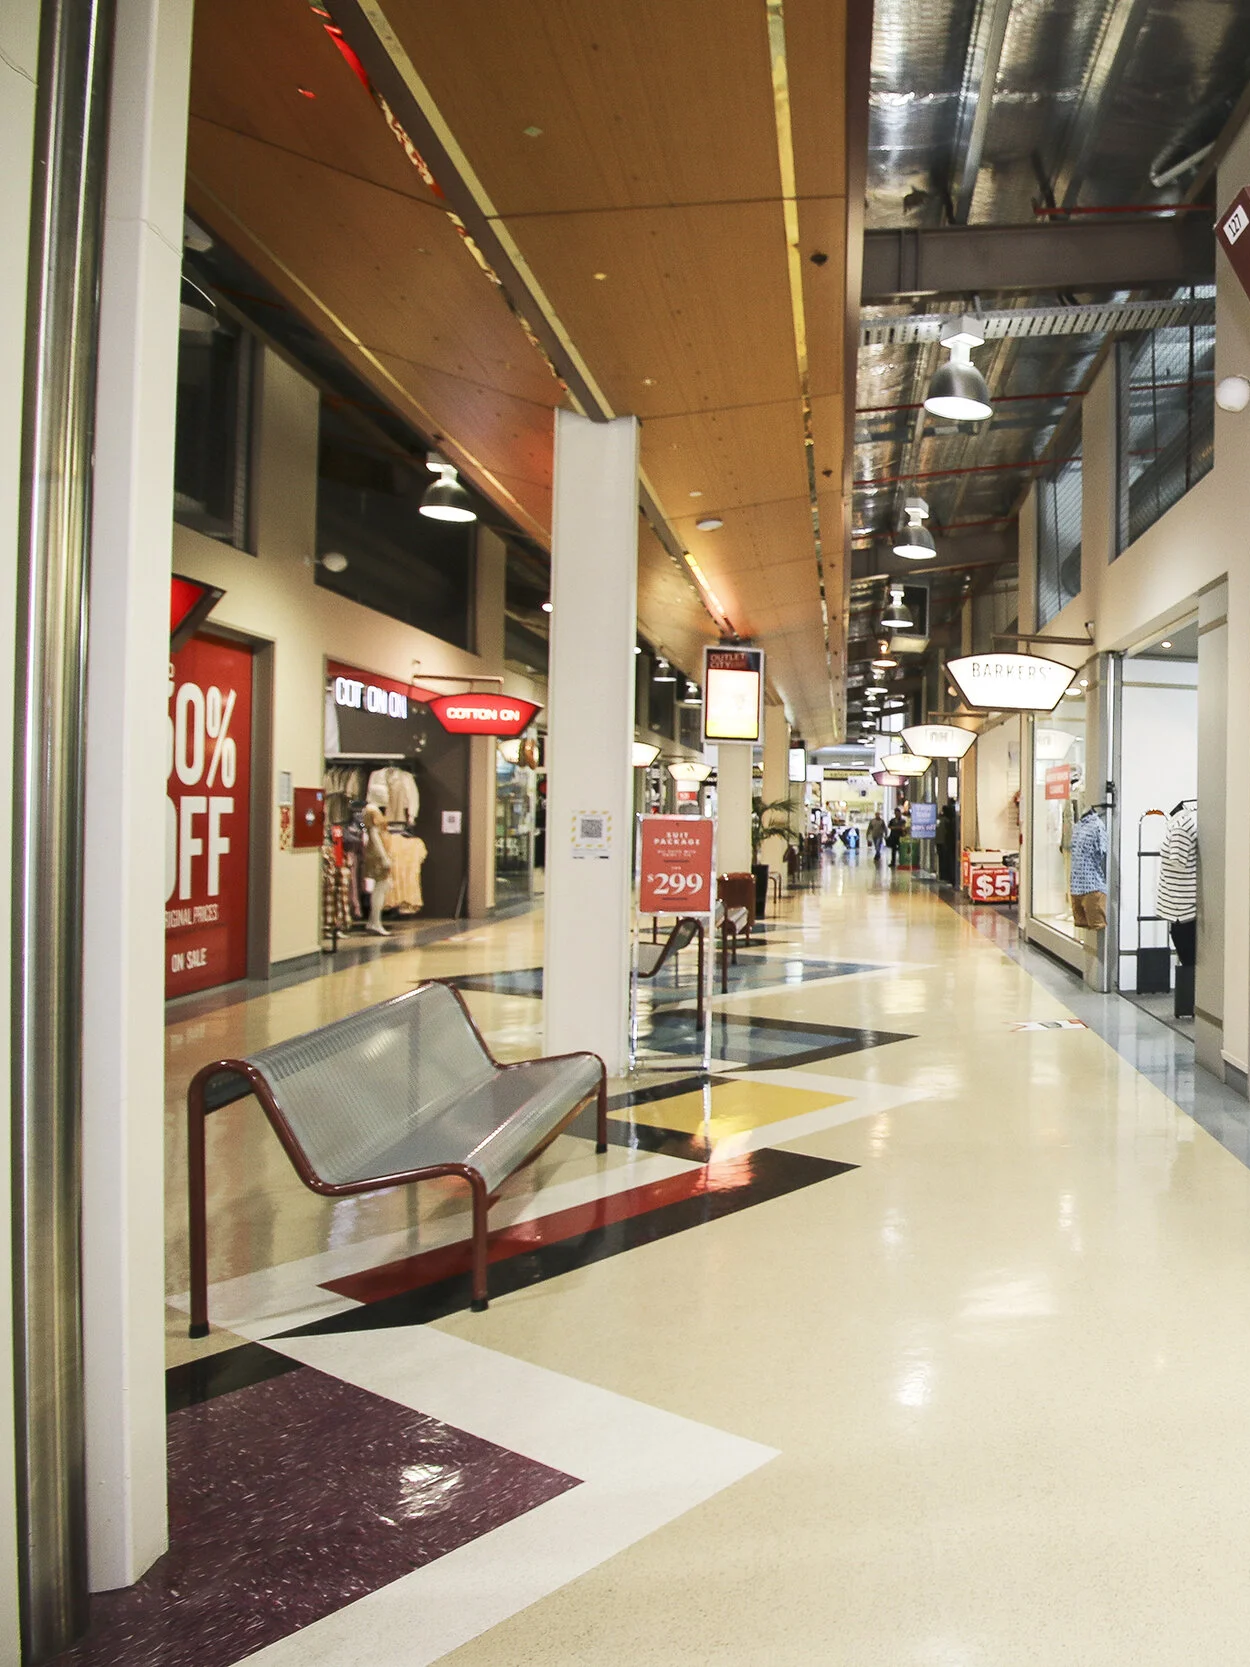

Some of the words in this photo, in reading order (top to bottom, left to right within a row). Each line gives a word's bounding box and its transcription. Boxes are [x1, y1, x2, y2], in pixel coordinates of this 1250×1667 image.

[1228, 213, 1242, 237] 127
[446, 707, 498, 720] COTTON
[500, 709, 520, 721] ON
[167, 682, 237, 788] 0%
[647, 873, 703, 895] $299
[976, 874, 1011, 899] $5
[171, 953, 184, 973] ON
[186, 948, 207, 969] SALE
